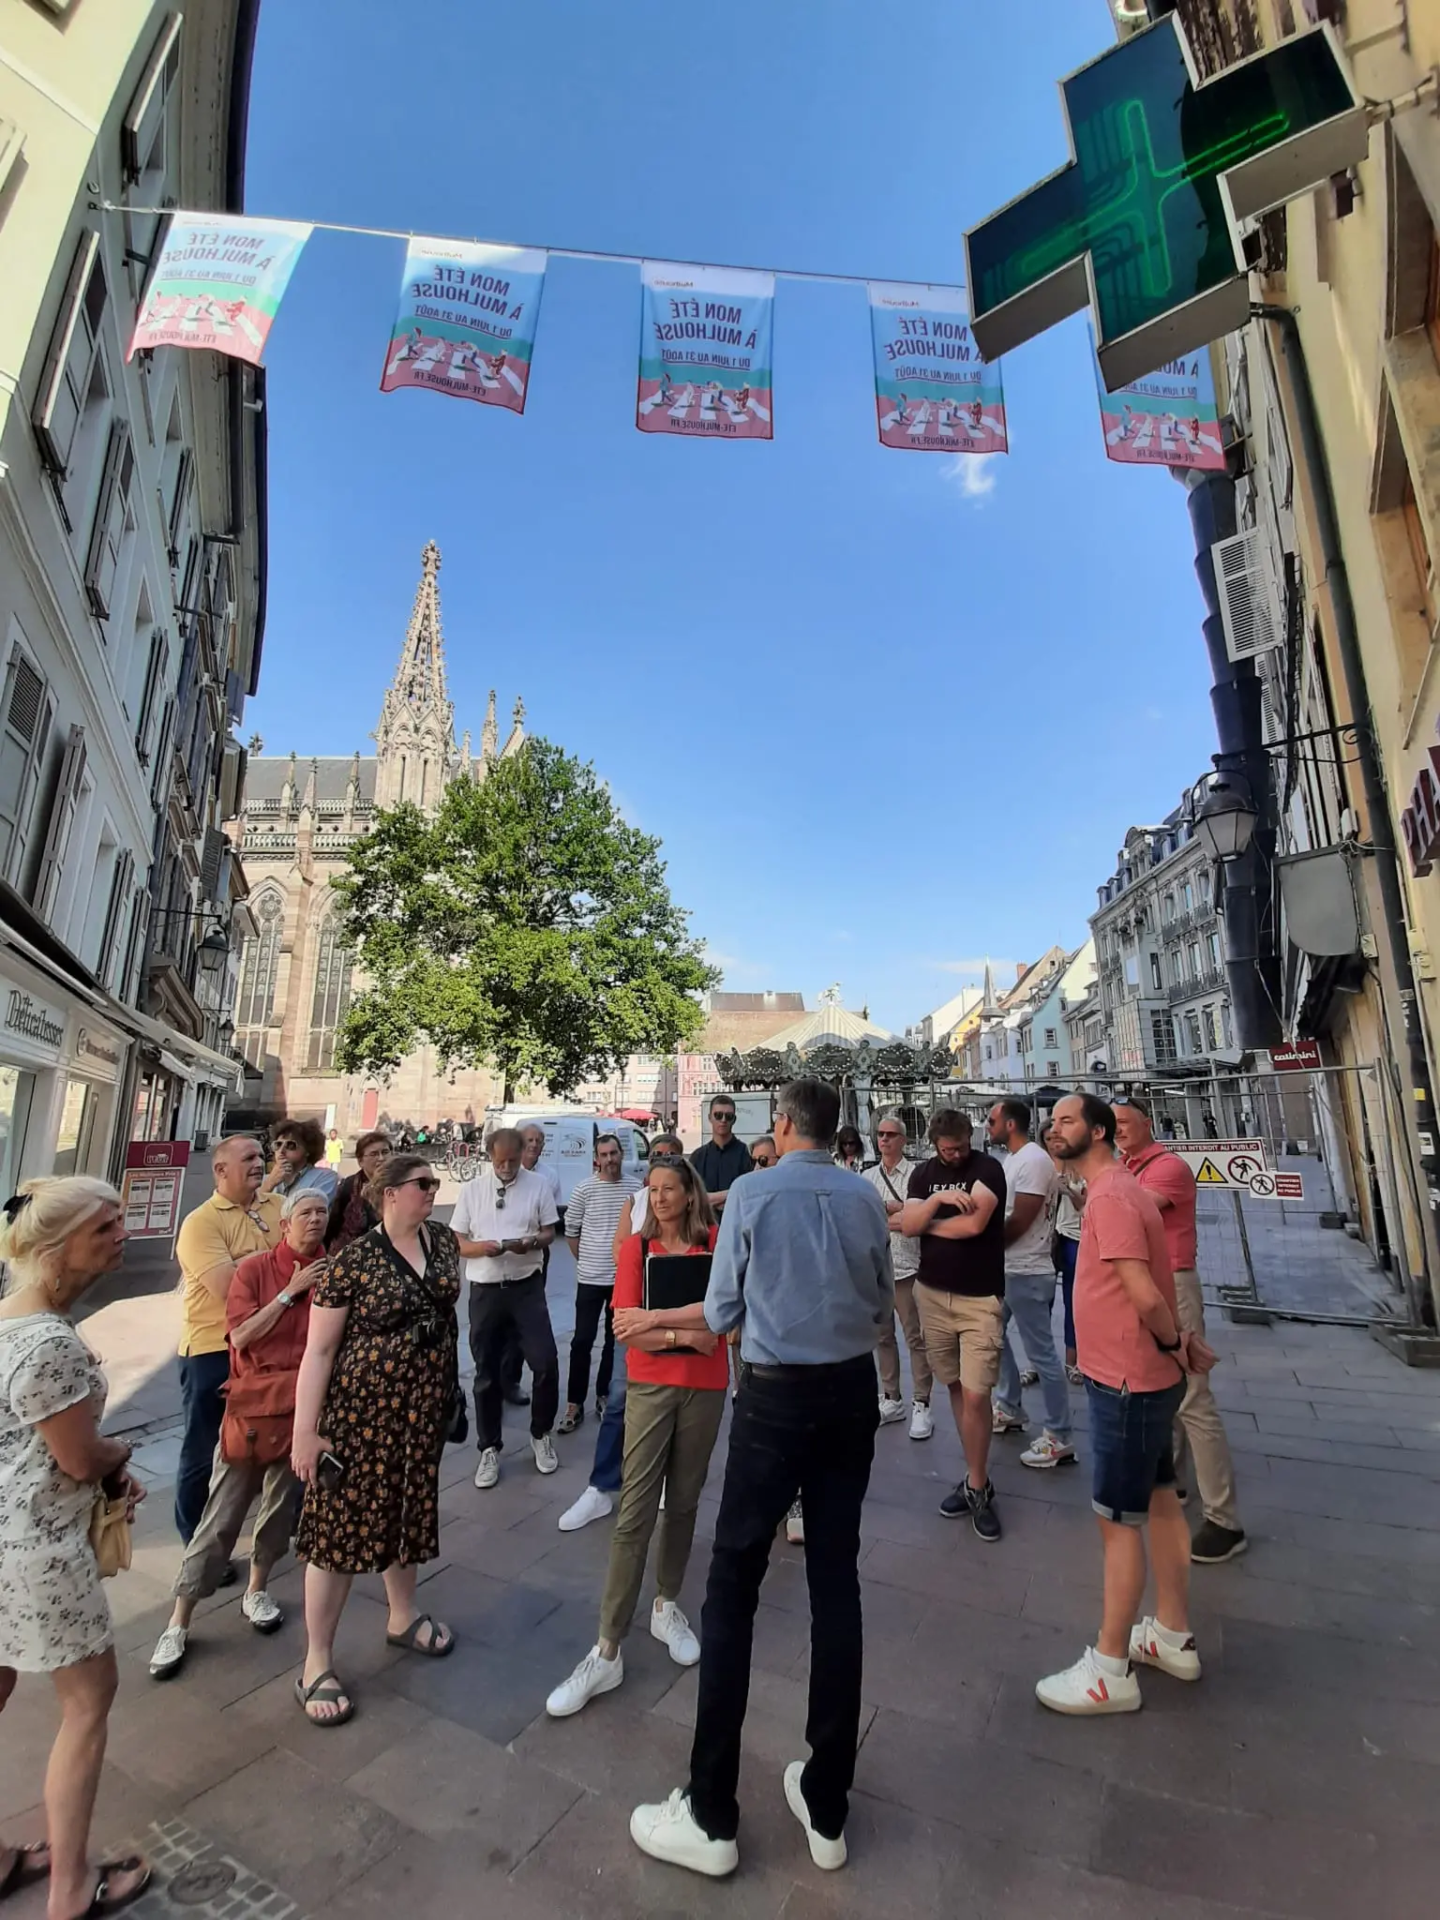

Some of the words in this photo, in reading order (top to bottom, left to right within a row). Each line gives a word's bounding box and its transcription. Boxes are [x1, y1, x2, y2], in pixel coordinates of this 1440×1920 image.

[1164, 1144, 1188, 1152] ANTIER
[1188, 1143, 1218, 1151] INTERDIT
[1220, 1143, 1230, 1151] AU
[1231, 1142, 1258, 1151] PUBLIC
